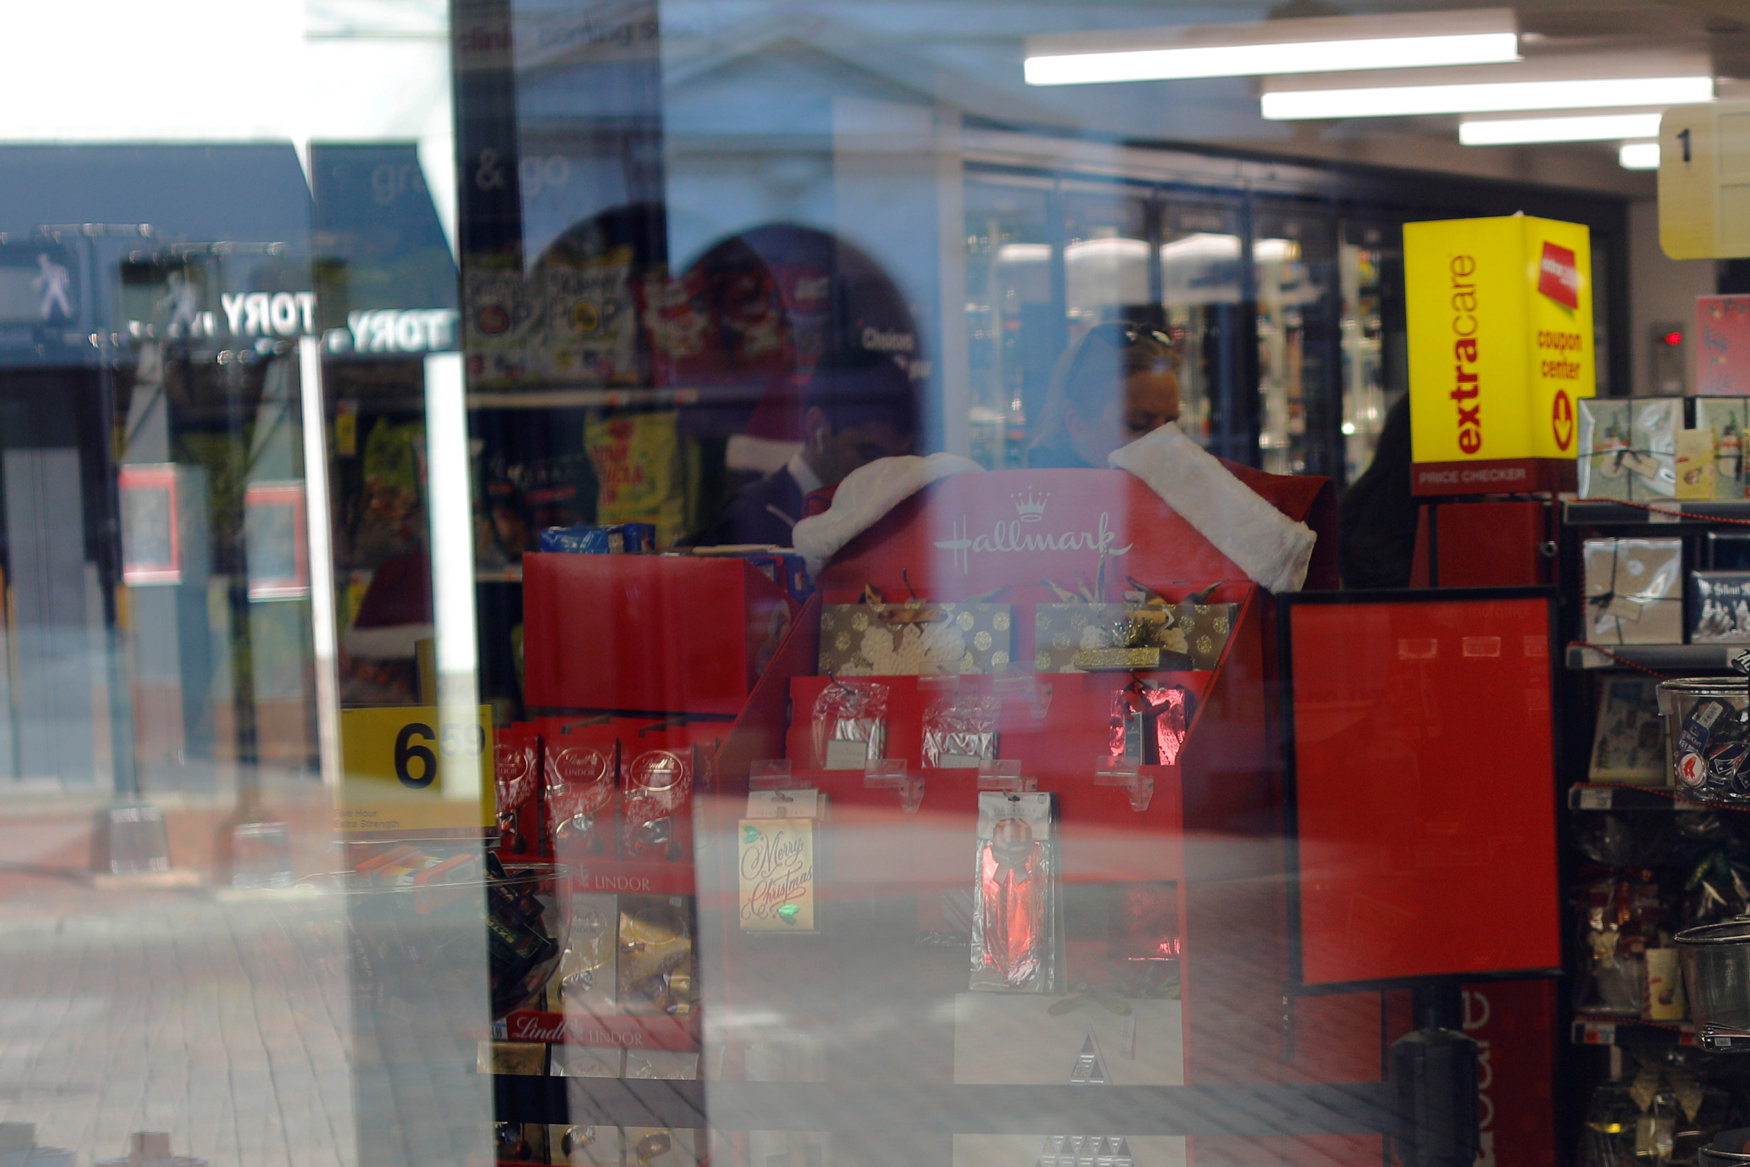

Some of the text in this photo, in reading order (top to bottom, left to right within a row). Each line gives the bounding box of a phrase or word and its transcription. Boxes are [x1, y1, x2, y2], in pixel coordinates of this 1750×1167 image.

[1676, 129, 1691, 162] 1
[1450, 253, 1482, 455] extracare
[1538, 331, 1582, 352] coupon
[1541, 360, 1580, 380] center
[1419, 467, 1526, 485] PRICE CHECKER
[933, 511, 1133, 575] Hallmark
[394, 722, 437, 790] 6
[741, 831, 805, 881] Merry
[594, 875, 651, 891] LINDOR
[741, 861, 812, 920] Christmas
